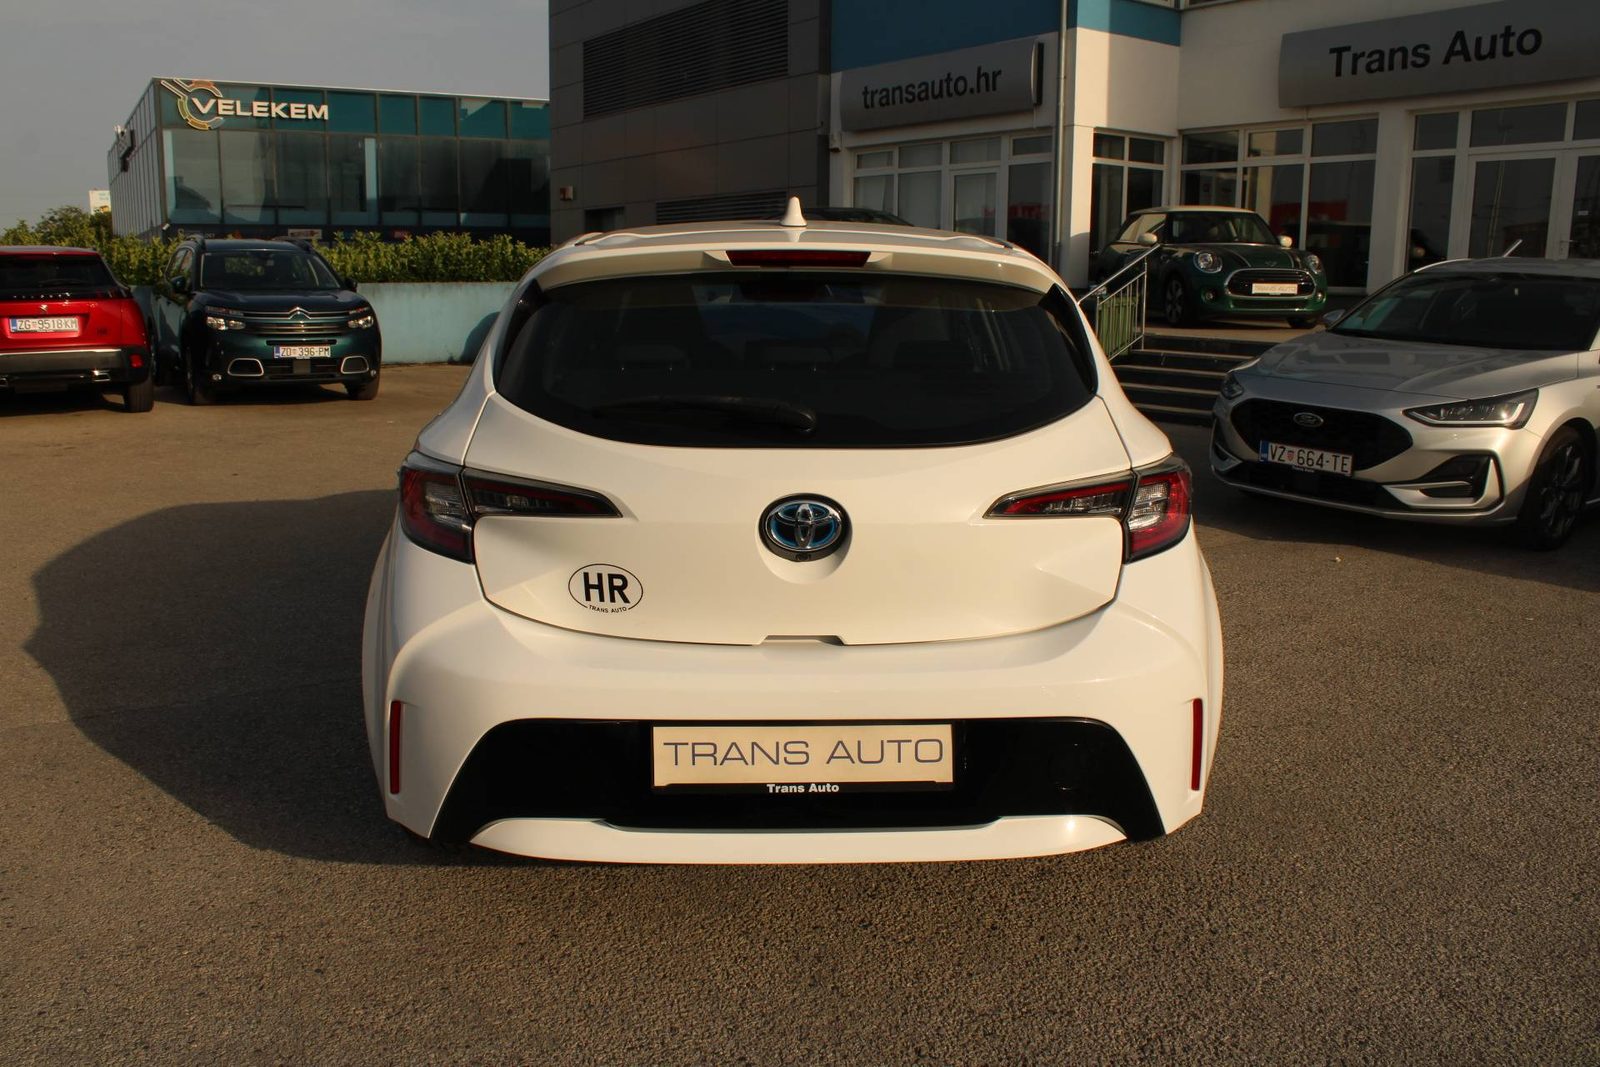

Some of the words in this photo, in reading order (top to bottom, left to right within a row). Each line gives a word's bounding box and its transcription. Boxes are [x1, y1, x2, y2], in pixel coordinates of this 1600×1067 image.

[1329, 43, 1430, 77] Trans
[1442, 25, 1543, 65] Auto
[862, 66, 1002, 109] transauto.hr
[192, 97, 329, 120] VELEKEM
[1270, 445, 1286, 462] VZ
[1297, 449, 1350, 473] 664-TE
[583, 571, 631, 604] HR
[589, 604, 609, 613] TRANS
[663, 741, 810, 766] TRANS
[826, 738, 943, 765] AUTO
[766, 783, 805, 793] Trans
[808, 783, 840, 793] Auto
